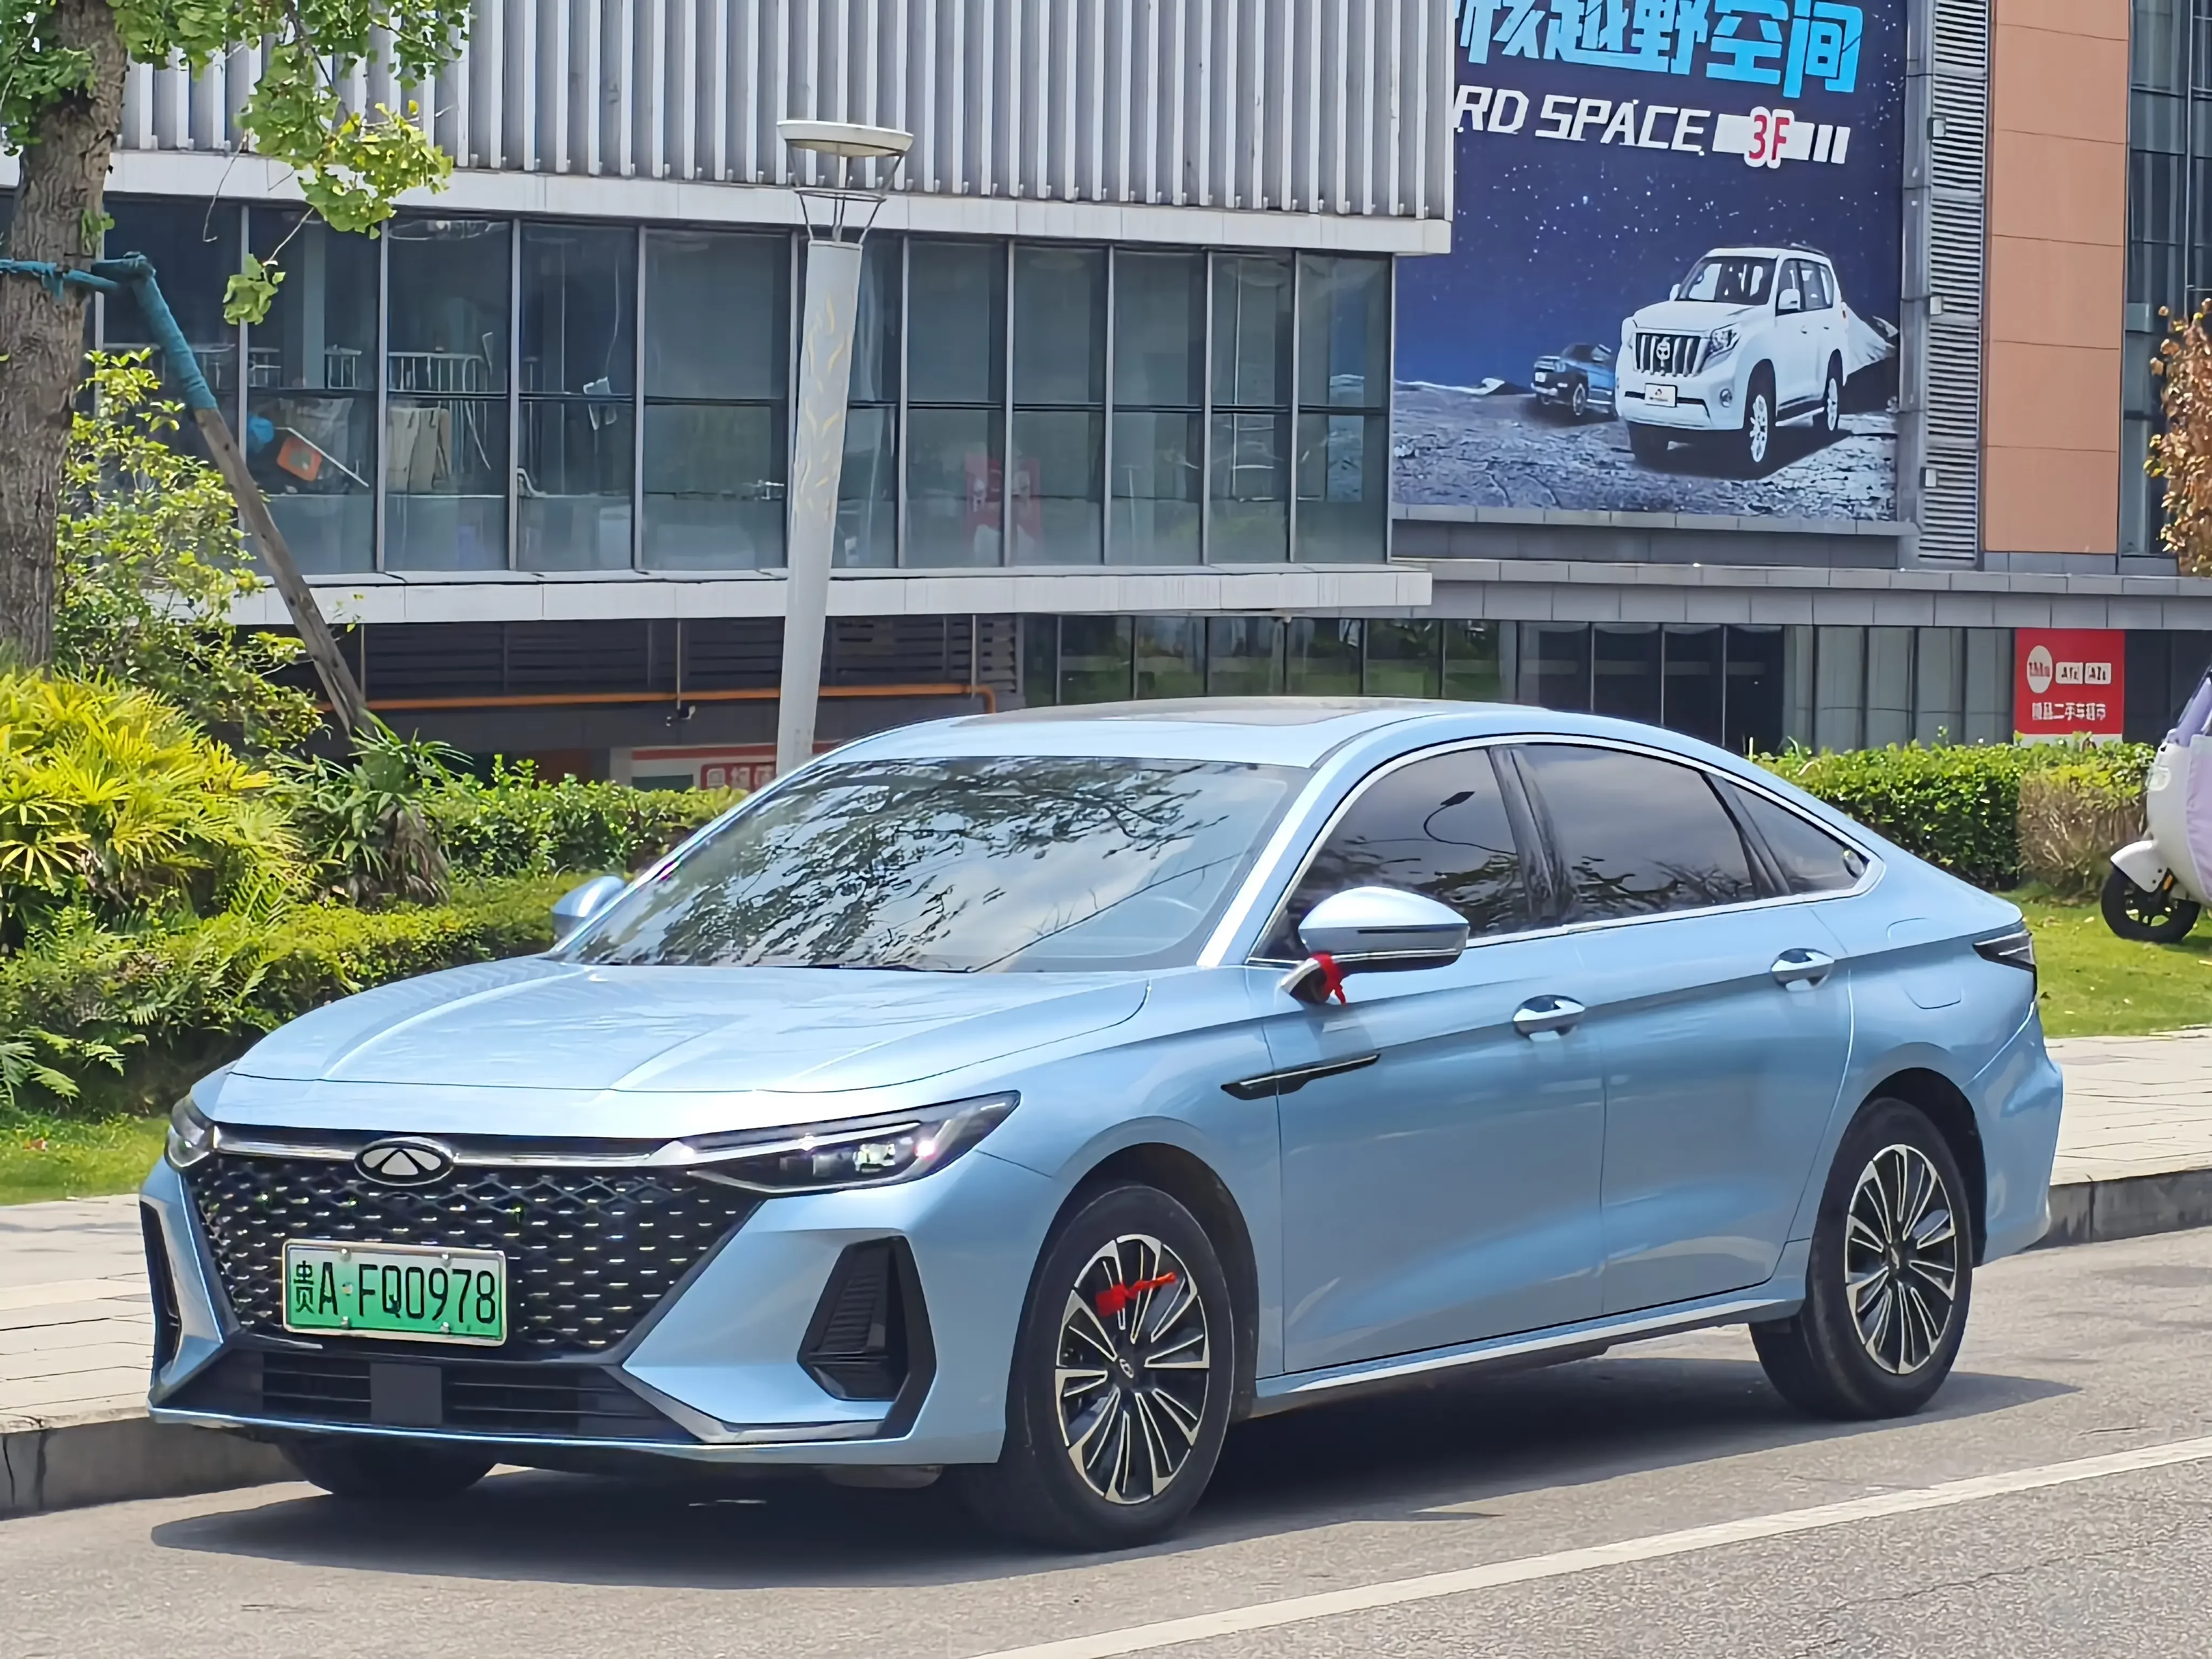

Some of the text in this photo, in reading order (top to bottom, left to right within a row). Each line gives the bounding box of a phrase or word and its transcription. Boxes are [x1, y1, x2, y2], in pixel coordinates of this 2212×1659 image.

[1454, 0, 1863, 98] 核越野空间
[1535, 94, 1711, 152] SPACE
[1748, 112, 1791, 162] 3F
